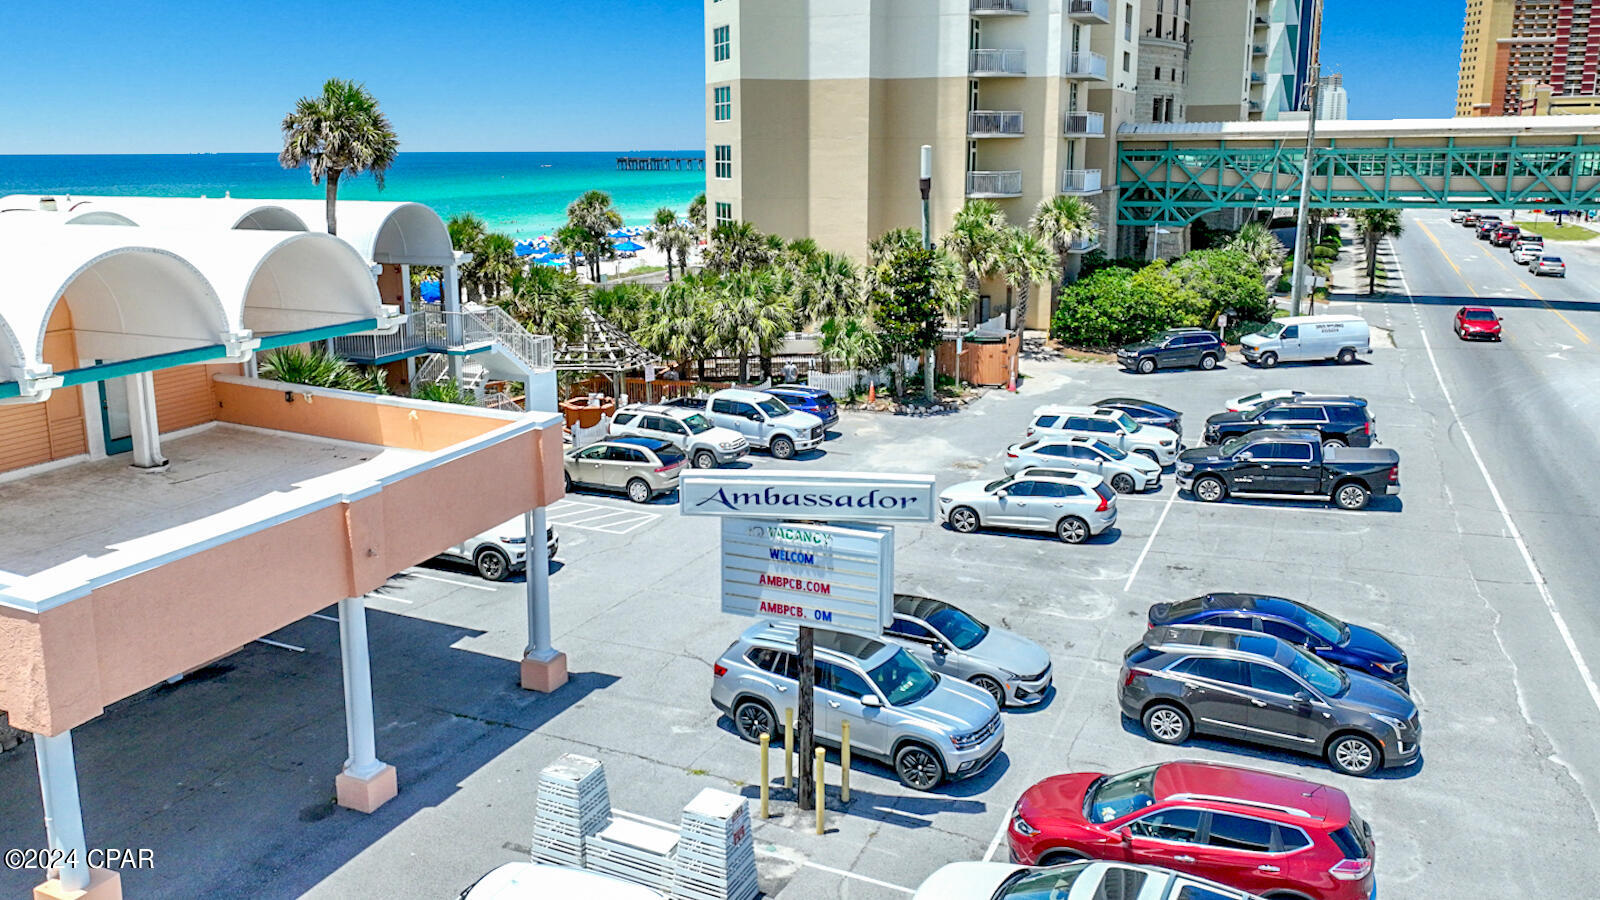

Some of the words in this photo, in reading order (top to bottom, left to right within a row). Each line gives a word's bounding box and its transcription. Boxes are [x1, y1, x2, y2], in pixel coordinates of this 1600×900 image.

[695, 487, 918, 511] Ambassador
[767, 527, 833, 545] VACANCY
[769, 548, 814, 565] WELCOM
[759, 574, 831, 594] AMBPCB.COM
